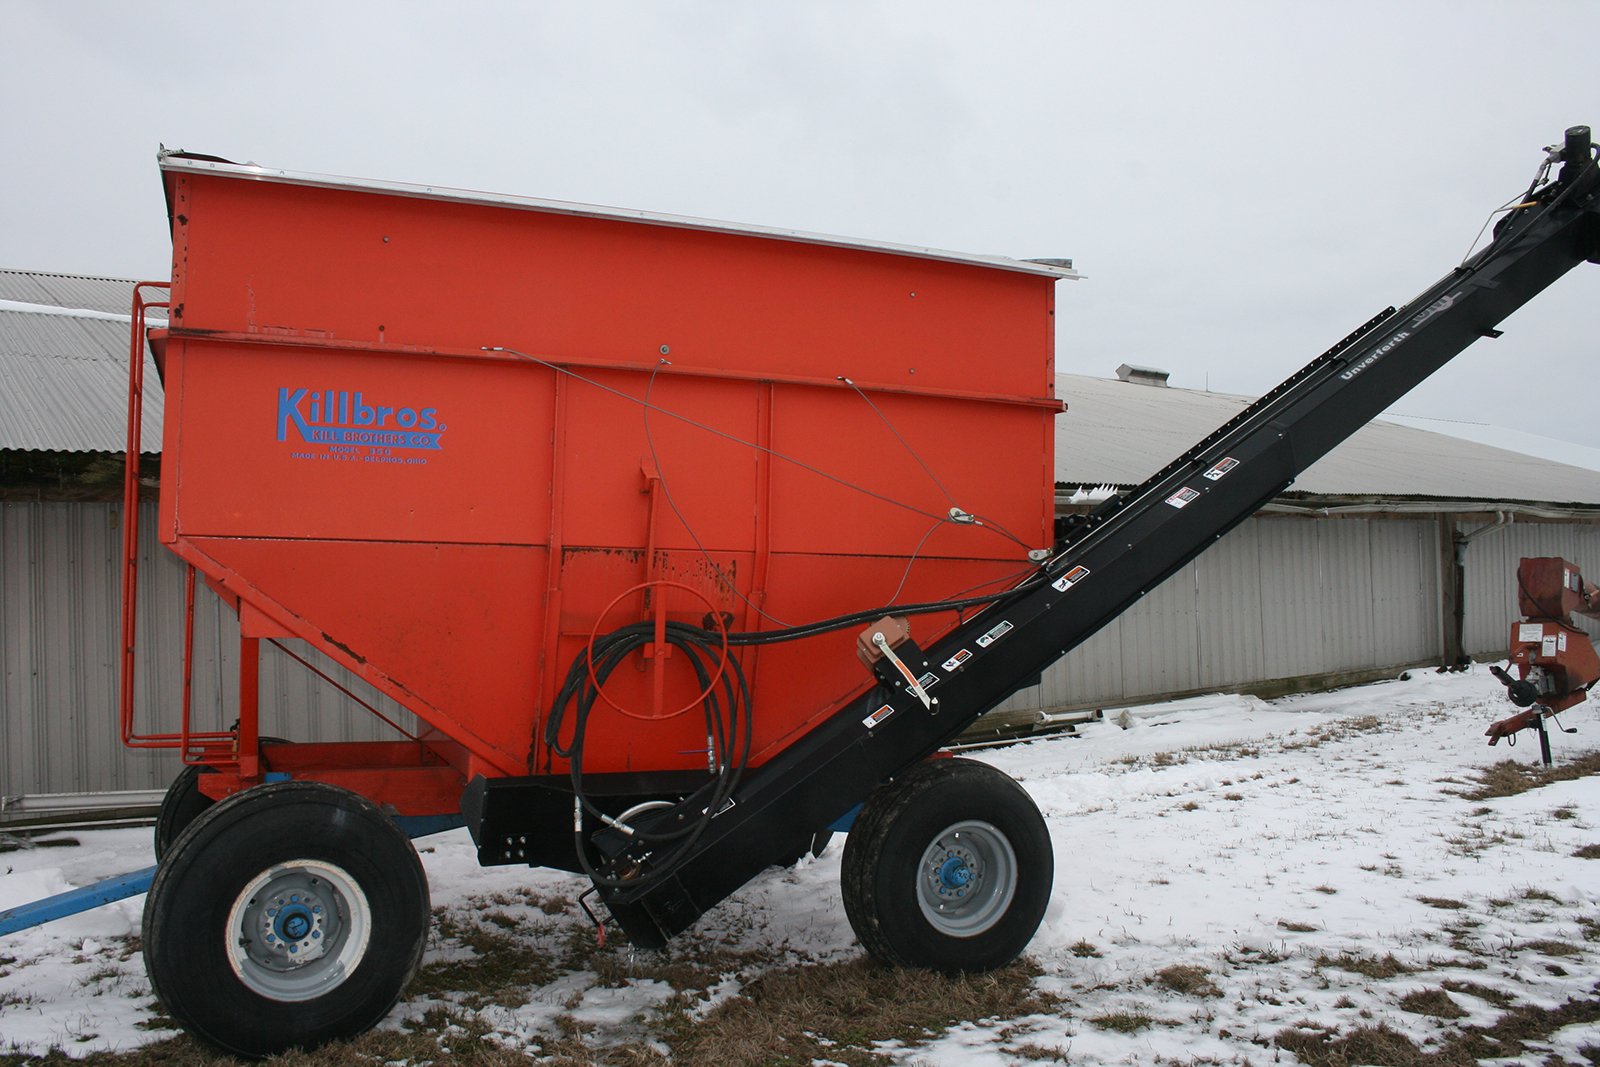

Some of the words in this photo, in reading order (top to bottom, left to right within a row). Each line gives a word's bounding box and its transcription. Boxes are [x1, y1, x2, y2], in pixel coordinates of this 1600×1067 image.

[312, 430, 338, 441] KILL
[343, 431, 406, 444] BROTHERS
[329, 446, 360, 454] MODEL
